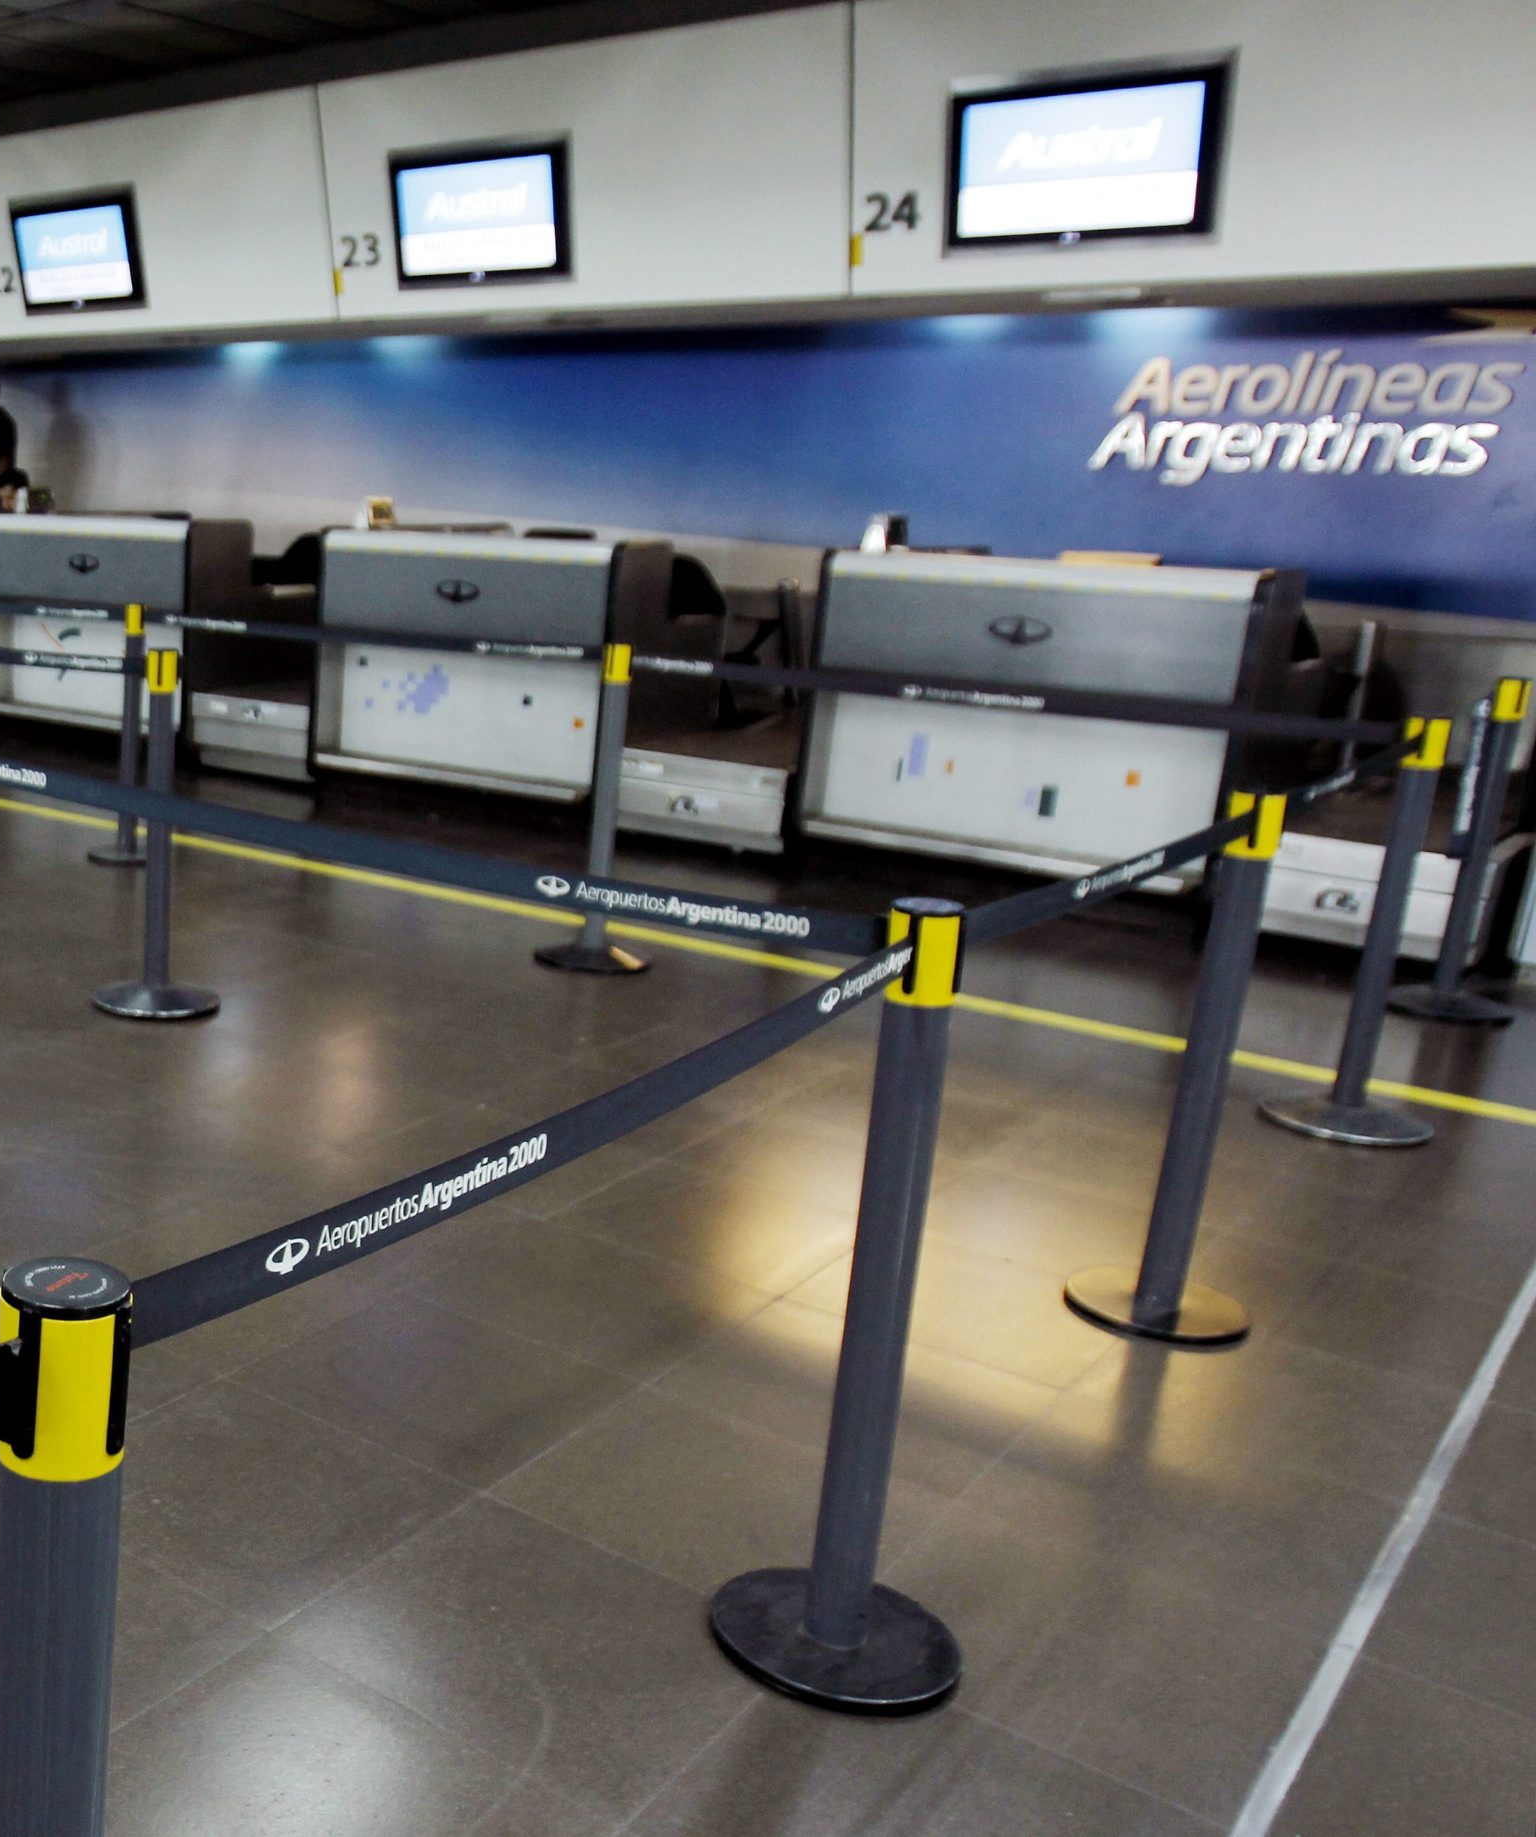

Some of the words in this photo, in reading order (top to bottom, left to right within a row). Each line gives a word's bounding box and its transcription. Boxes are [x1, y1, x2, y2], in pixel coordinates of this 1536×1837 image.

[865, 190, 920, 231] 24
[341, 232, 380, 267] 23
[1113, 348, 1526, 416] Aerolíneas
[1087, 411, 1501, 487] Argentinas
[762, 910, 811, 938] 2000
[507, 1133, 548, 1174] 2000
